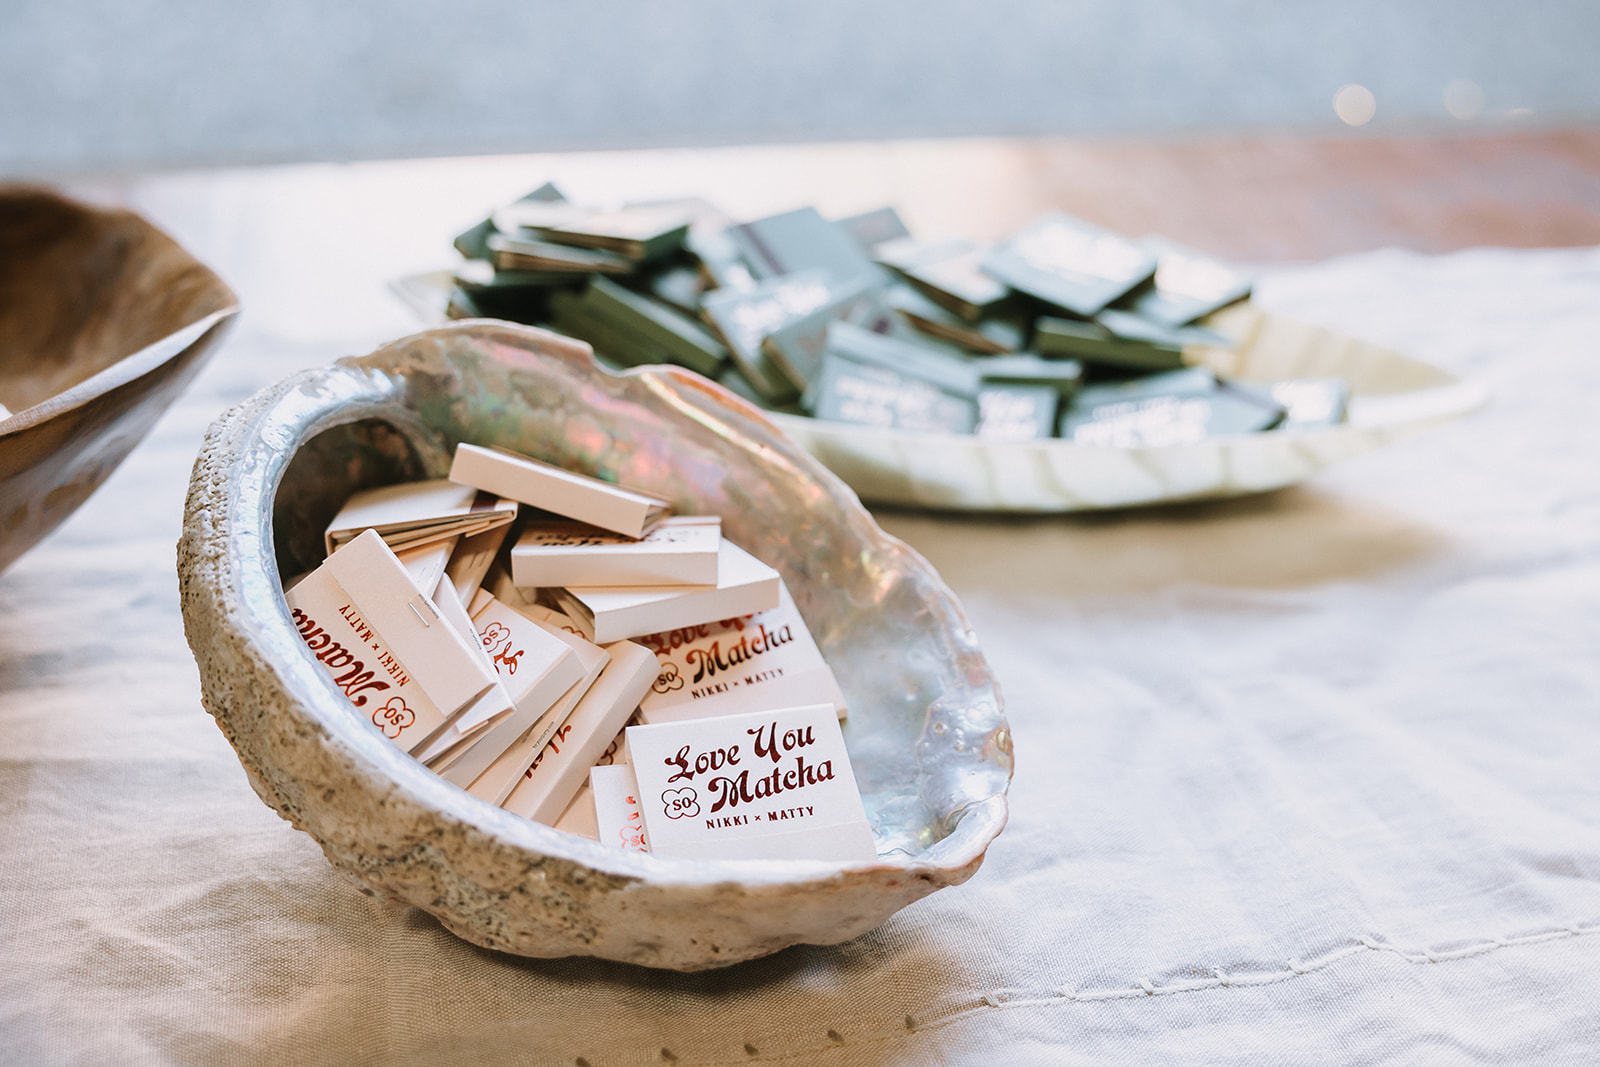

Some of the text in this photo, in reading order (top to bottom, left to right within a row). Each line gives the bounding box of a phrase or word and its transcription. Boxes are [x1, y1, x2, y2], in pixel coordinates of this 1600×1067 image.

[338, 604, 375, 643] MATTY
[377, 651, 411, 688] NIKKI
[685, 624, 794, 684] Matcha
[691, 681, 729, 699] NIKKI
[744, 667, 784, 685] MATTY
[664, 721, 816, 783] Love You
[707, 756, 836, 814] Matcha
[706, 814, 749, 830] NIKKI
[768, 805, 815, 822] MATTY
